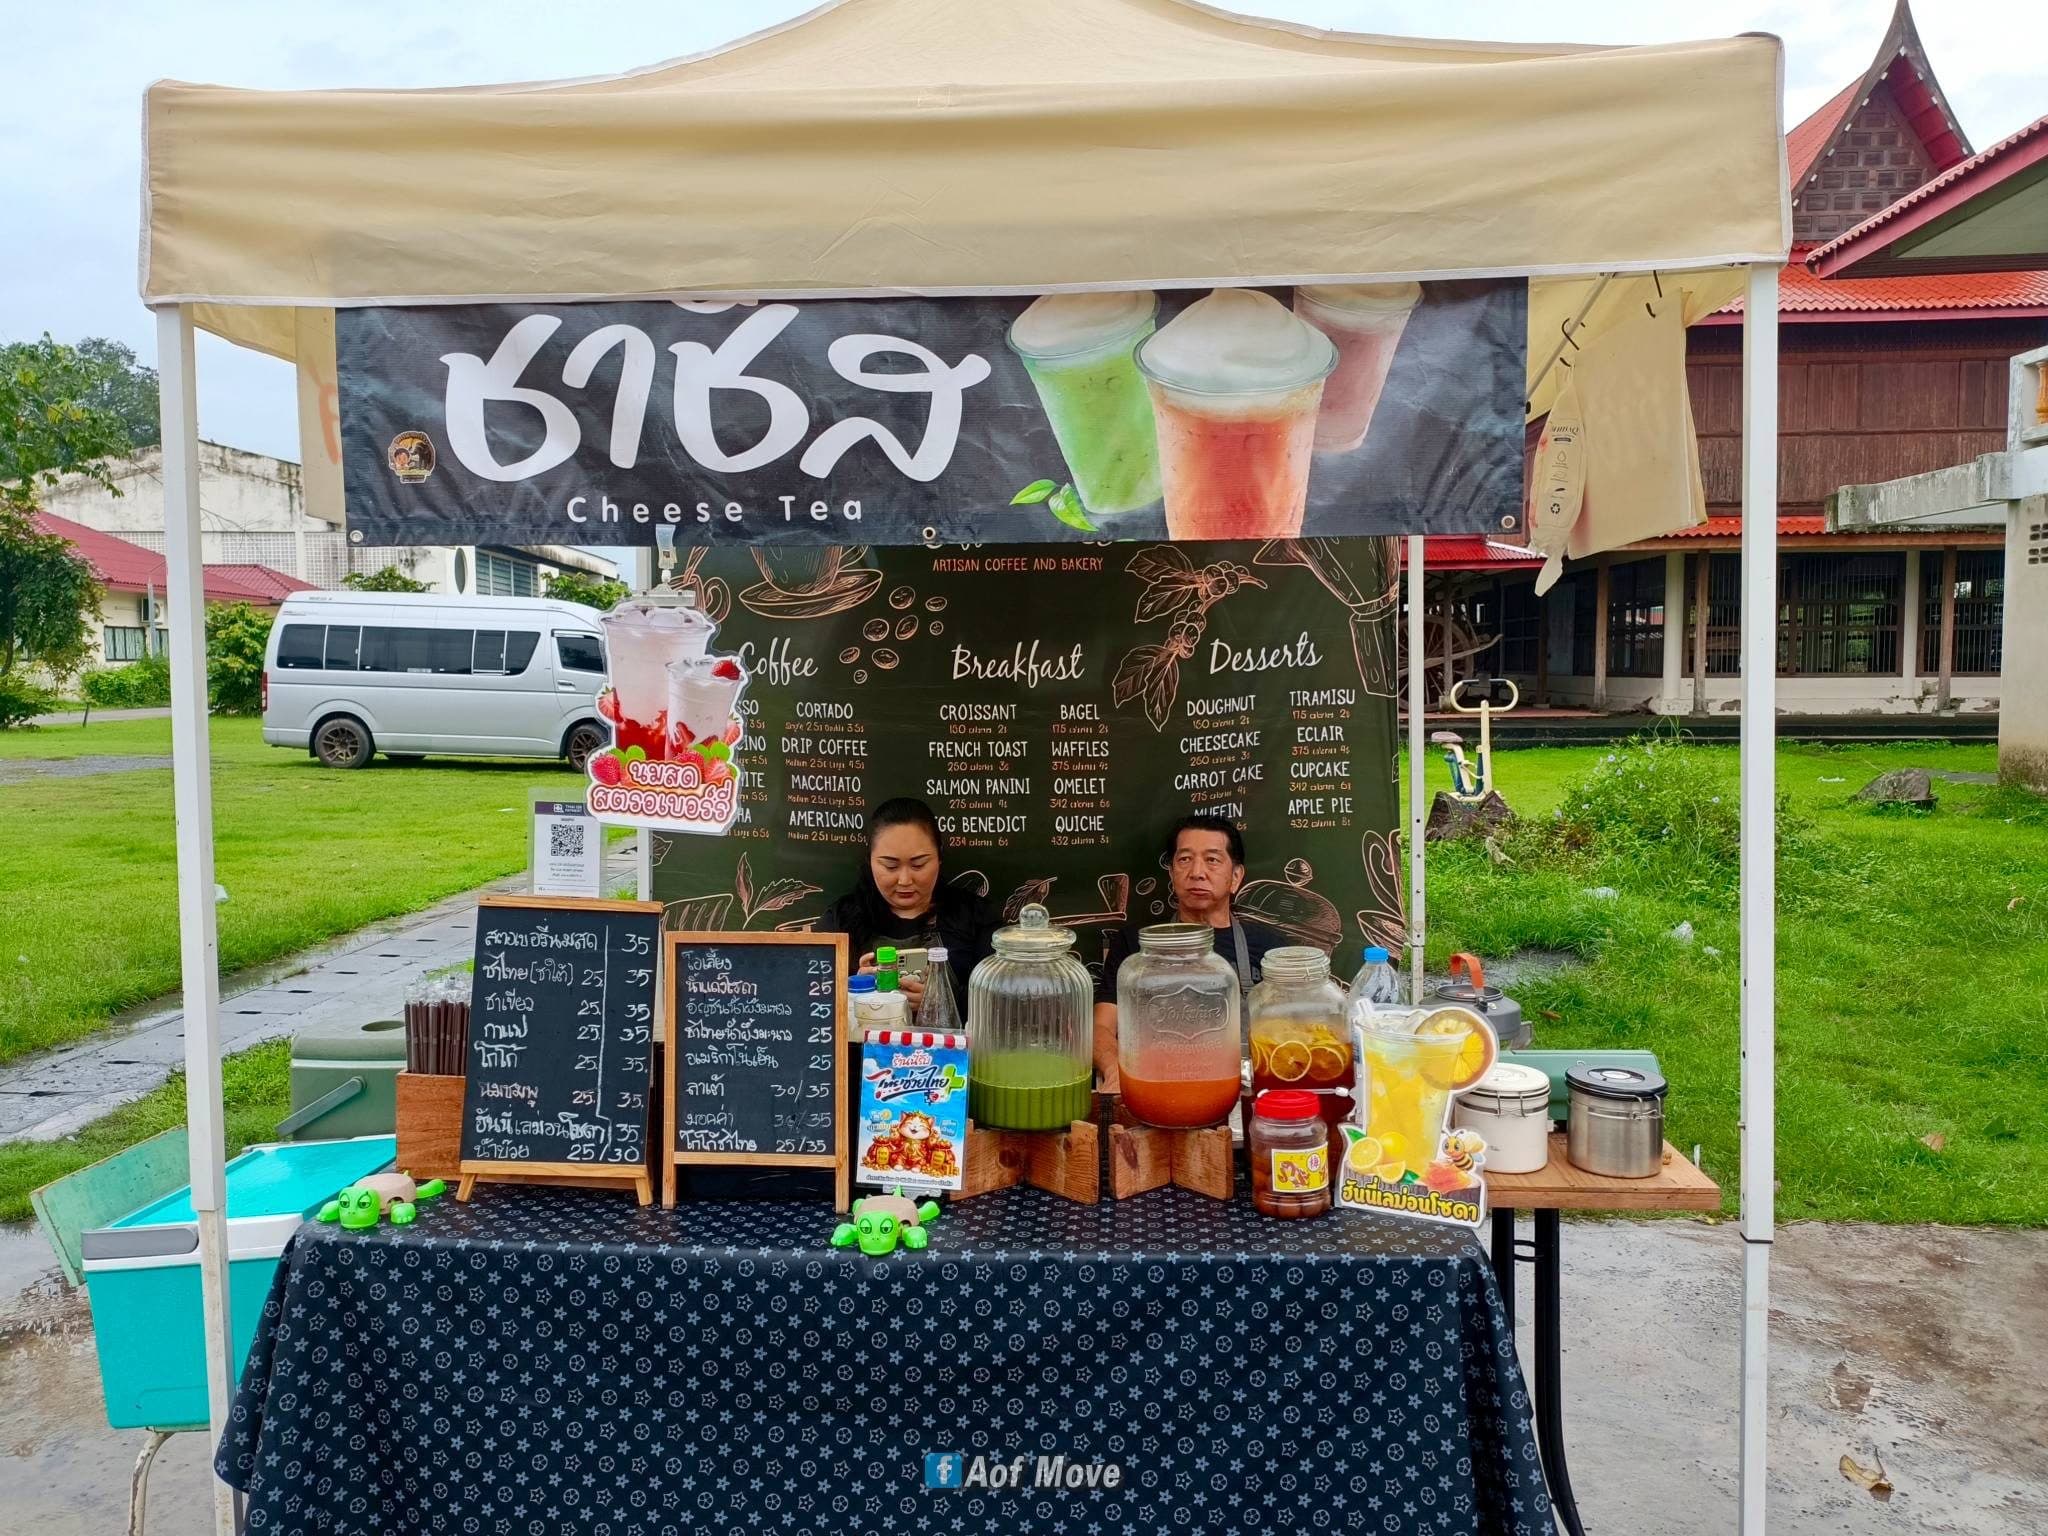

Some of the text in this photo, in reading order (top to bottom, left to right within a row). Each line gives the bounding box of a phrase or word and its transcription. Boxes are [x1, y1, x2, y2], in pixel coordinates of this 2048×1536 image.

[439, 301, 991, 482] ชาชส
[567, 495, 863, 524] Cheese Tea
[933, 558, 1104, 572] ARTISAN COFFEE AND BAKERY
[738, 637, 819, 686] Coffee
[1210, 631, 1323, 675] Desserts
[952, 640, 1086, 688] Breakfast
[1187, 695, 1256, 716] DOUGHNUT
[1290, 689, 1355, 706] TIRAMISU
[796, 702, 853, 718] CORTADO
[940, 704, 1017, 720] CROISSANT
[1061, 704, 1100, 720] BAGEL
[1180, 731, 1261, 754] CHEESECAKE
[1298, 726, 1344, 743] ECLAIR
[782, 737, 815, 754] DRIP
[819, 740, 868, 757] COFFEE
[929, 742, 1028, 758] FRENCH TOAST
[1052, 741, 1109, 757] WAFFLES
[629, 762, 699, 787] นมสด
[1175, 764, 1264, 791] CARROT CAKE
[1290, 762, 1350, 778] CUPCAKE
[792, 775, 861, 793] MACCHIATO
[926, 778, 1030, 795] SALMON PANINI
[1054, 778, 1106, 794] OMELET
[593, 778, 733, 821] สตรอเบอร์รี่
[1288, 798, 1353, 815] APPLE PIE
[789, 810, 863, 829] AMERICANO
[935, 816, 1027, 833] GG BENEDICT
[1055, 816, 1104, 833] QUICHE
[622, 934, 651, 954] 35
[808, 960, 832, 974] 25
[625, 969, 652, 986] 35
[809, 981, 833, 996] 25
[485, 989, 534, 1012] ชาเขียว
[624, 1004, 651, 1021] 35
[810, 1003, 831, 1018] 25
[484, 1015, 528, 1040] กาแฟ
[808, 1028, 832, 1043] 25
[474, 1041, 527, 1068] โกโก้
[809, 1055, 832, 1070] 25
[686, 1073, 725, 1096] ลาเต้
[480, 1082, 539, 1108] นมชมพู
[1342, 1176, 1479, 1221] ฮันนี่เลม่อนโซดา
